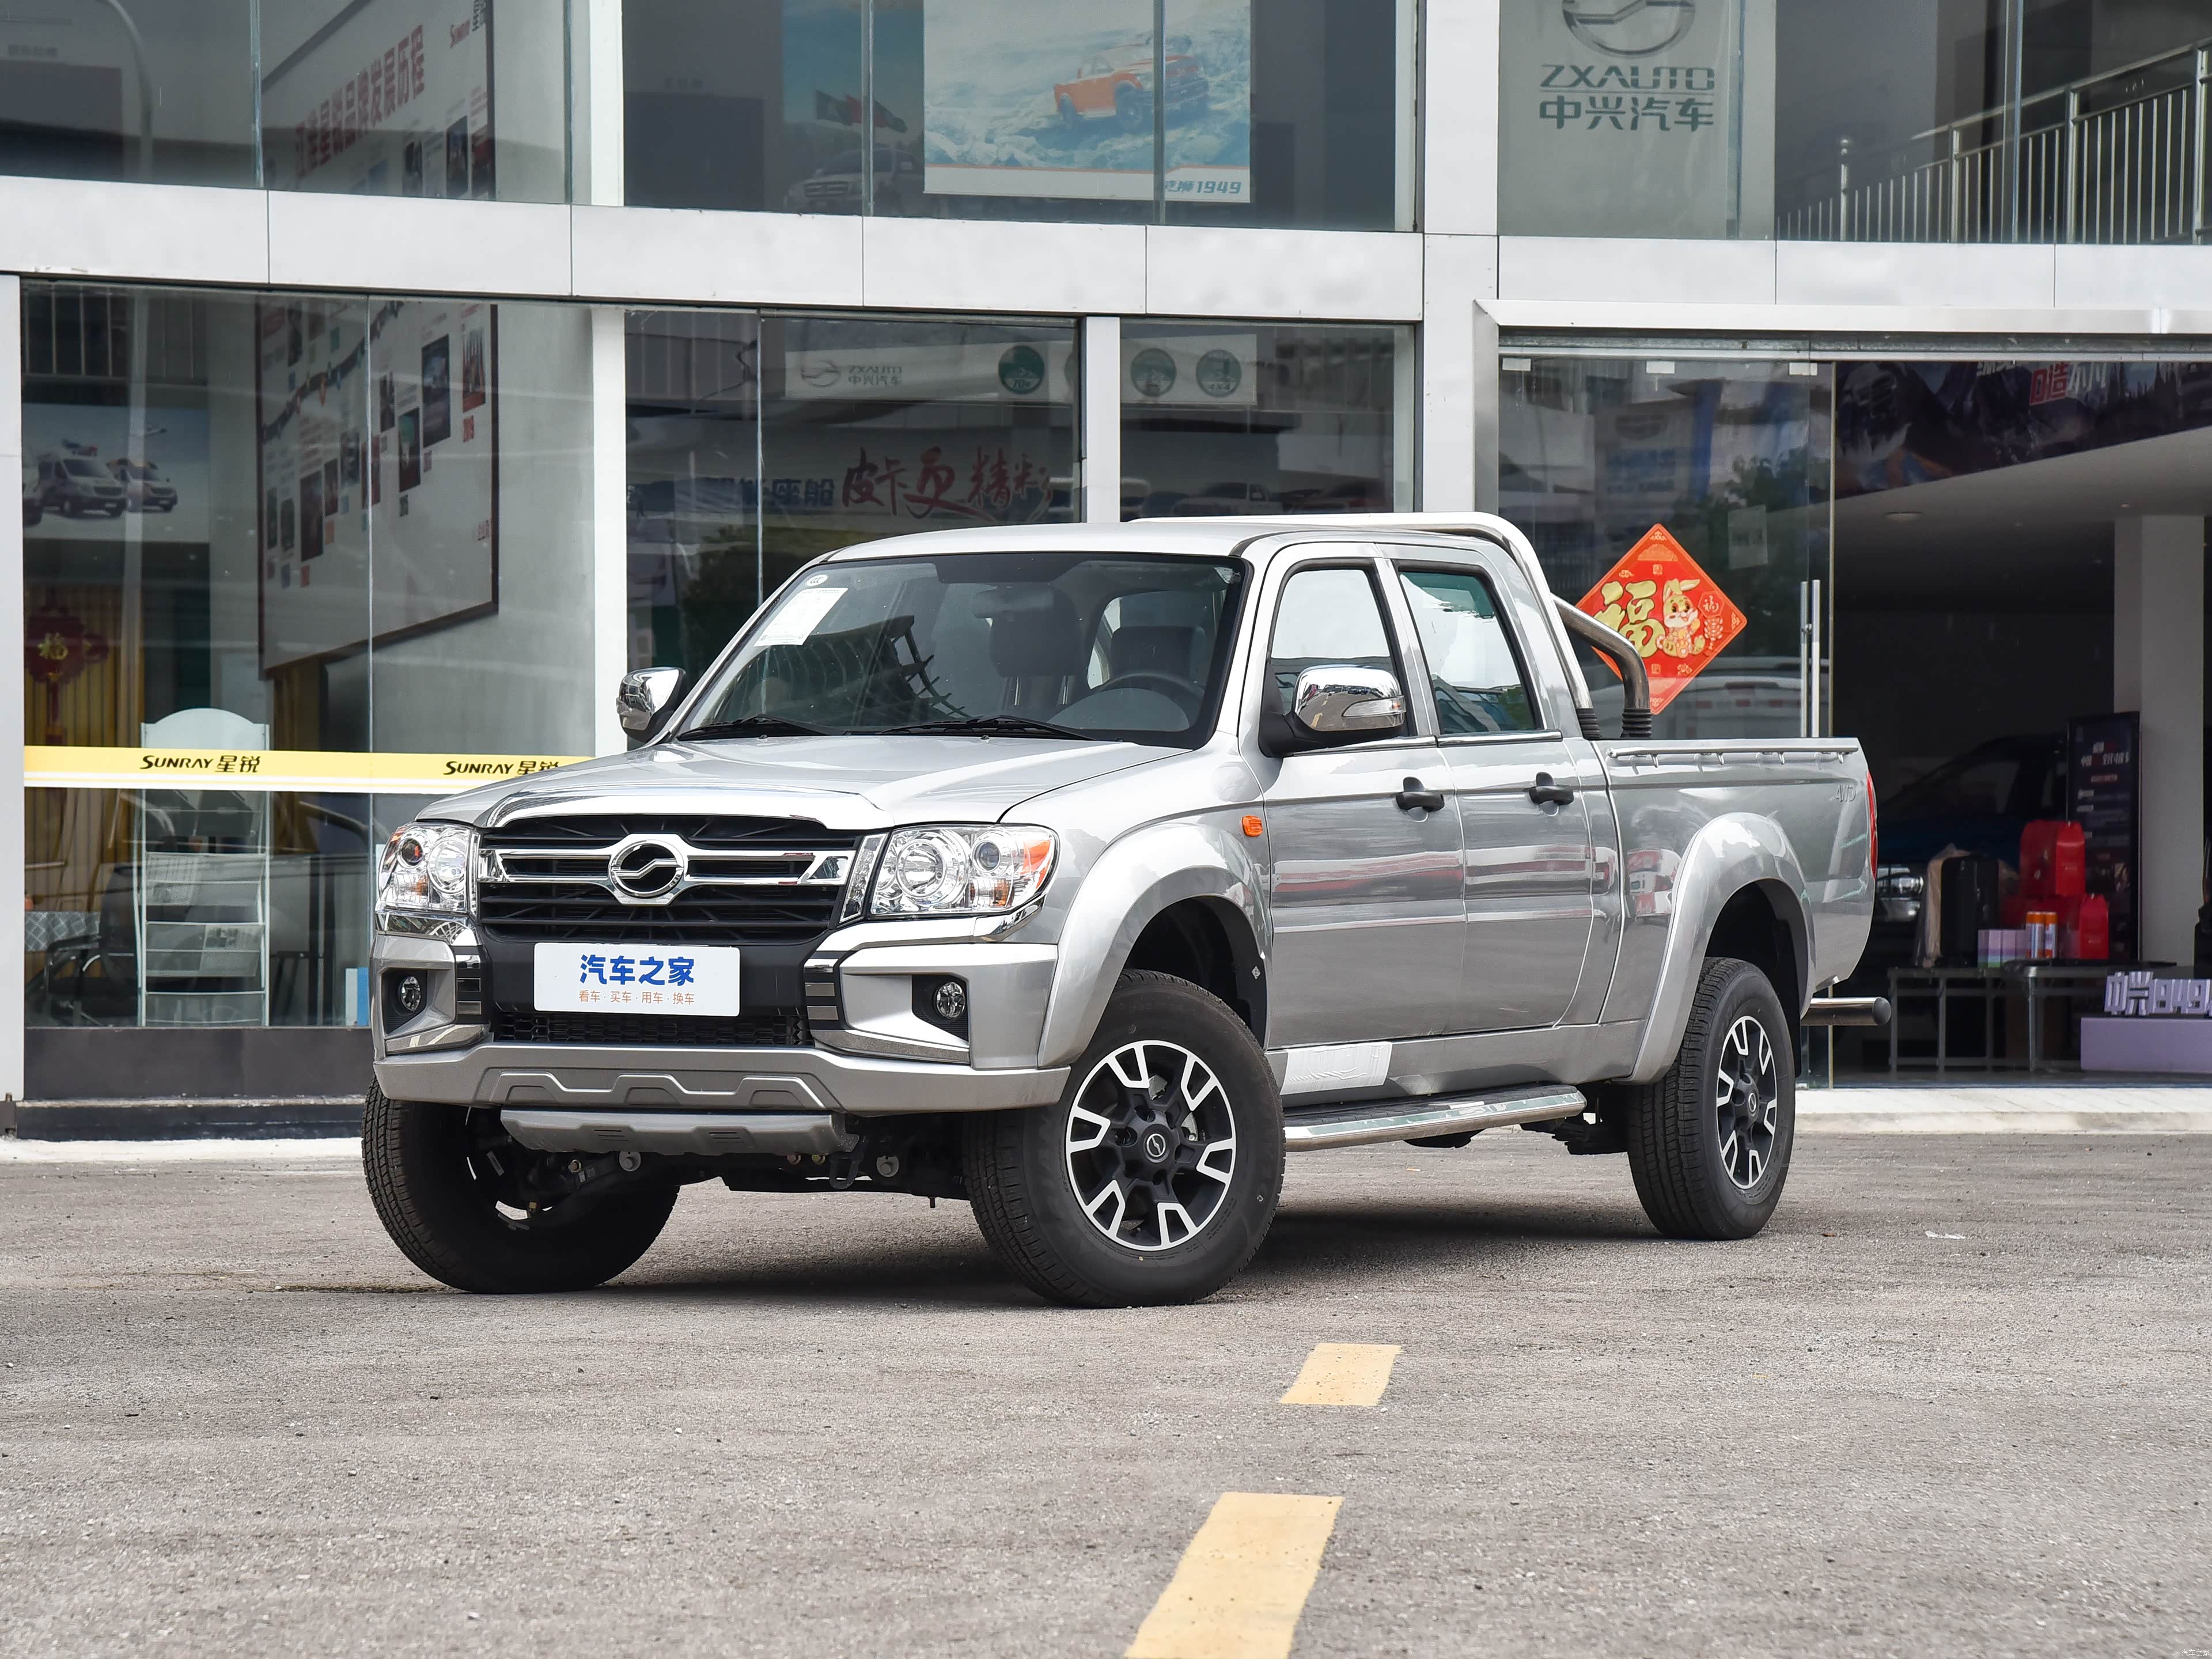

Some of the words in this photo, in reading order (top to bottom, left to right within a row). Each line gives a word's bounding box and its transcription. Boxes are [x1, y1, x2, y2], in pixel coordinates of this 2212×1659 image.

[1539, 64, 1715, 90] ZXAUTO
[1539, 95, 1714, 132] 中兴汽车
[139, 755, 213, 770] SUNRAY
[215, 755, 261, 773] 星锐
[443, 760, 514, 775] SUNRAY
[579, 955, 694, 986] 汽车之家
